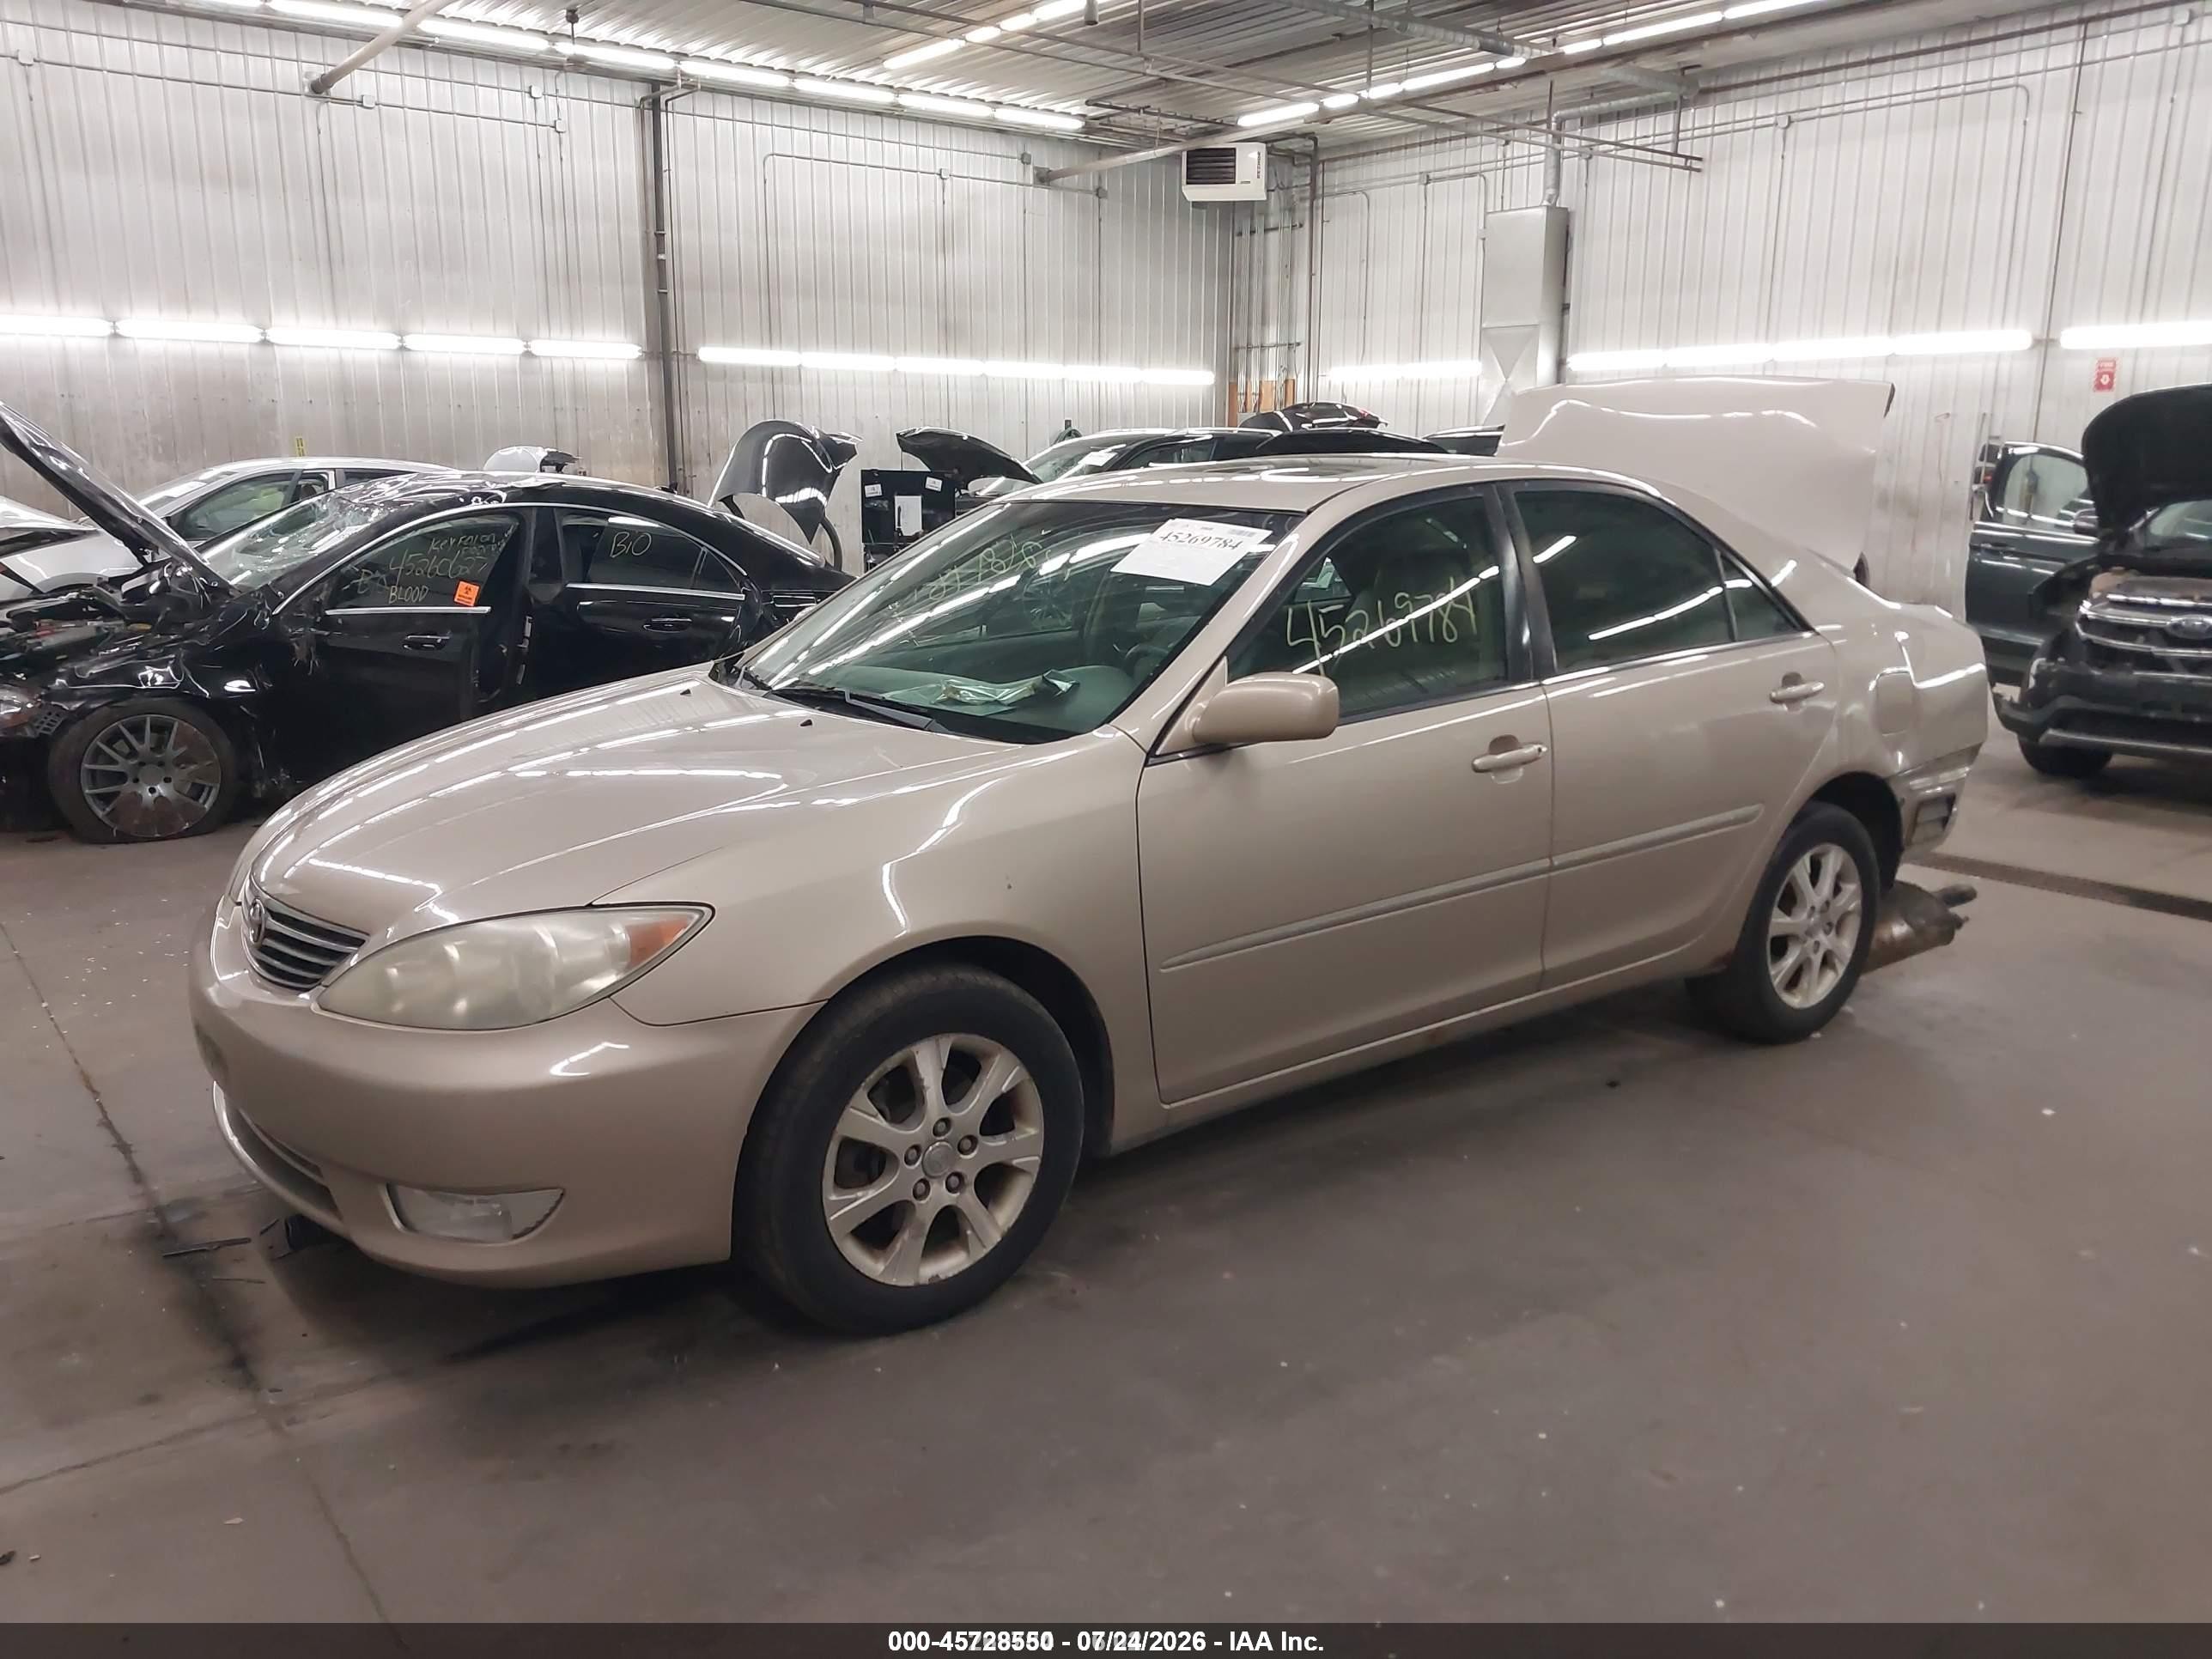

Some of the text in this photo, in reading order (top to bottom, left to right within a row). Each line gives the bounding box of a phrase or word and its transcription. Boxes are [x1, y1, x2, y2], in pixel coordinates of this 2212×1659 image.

[1159, 531, 1243, 550] 45269784
[388, 585, 428, 605] BLOOD
[1286, 576, 1477, 676] 45269784
